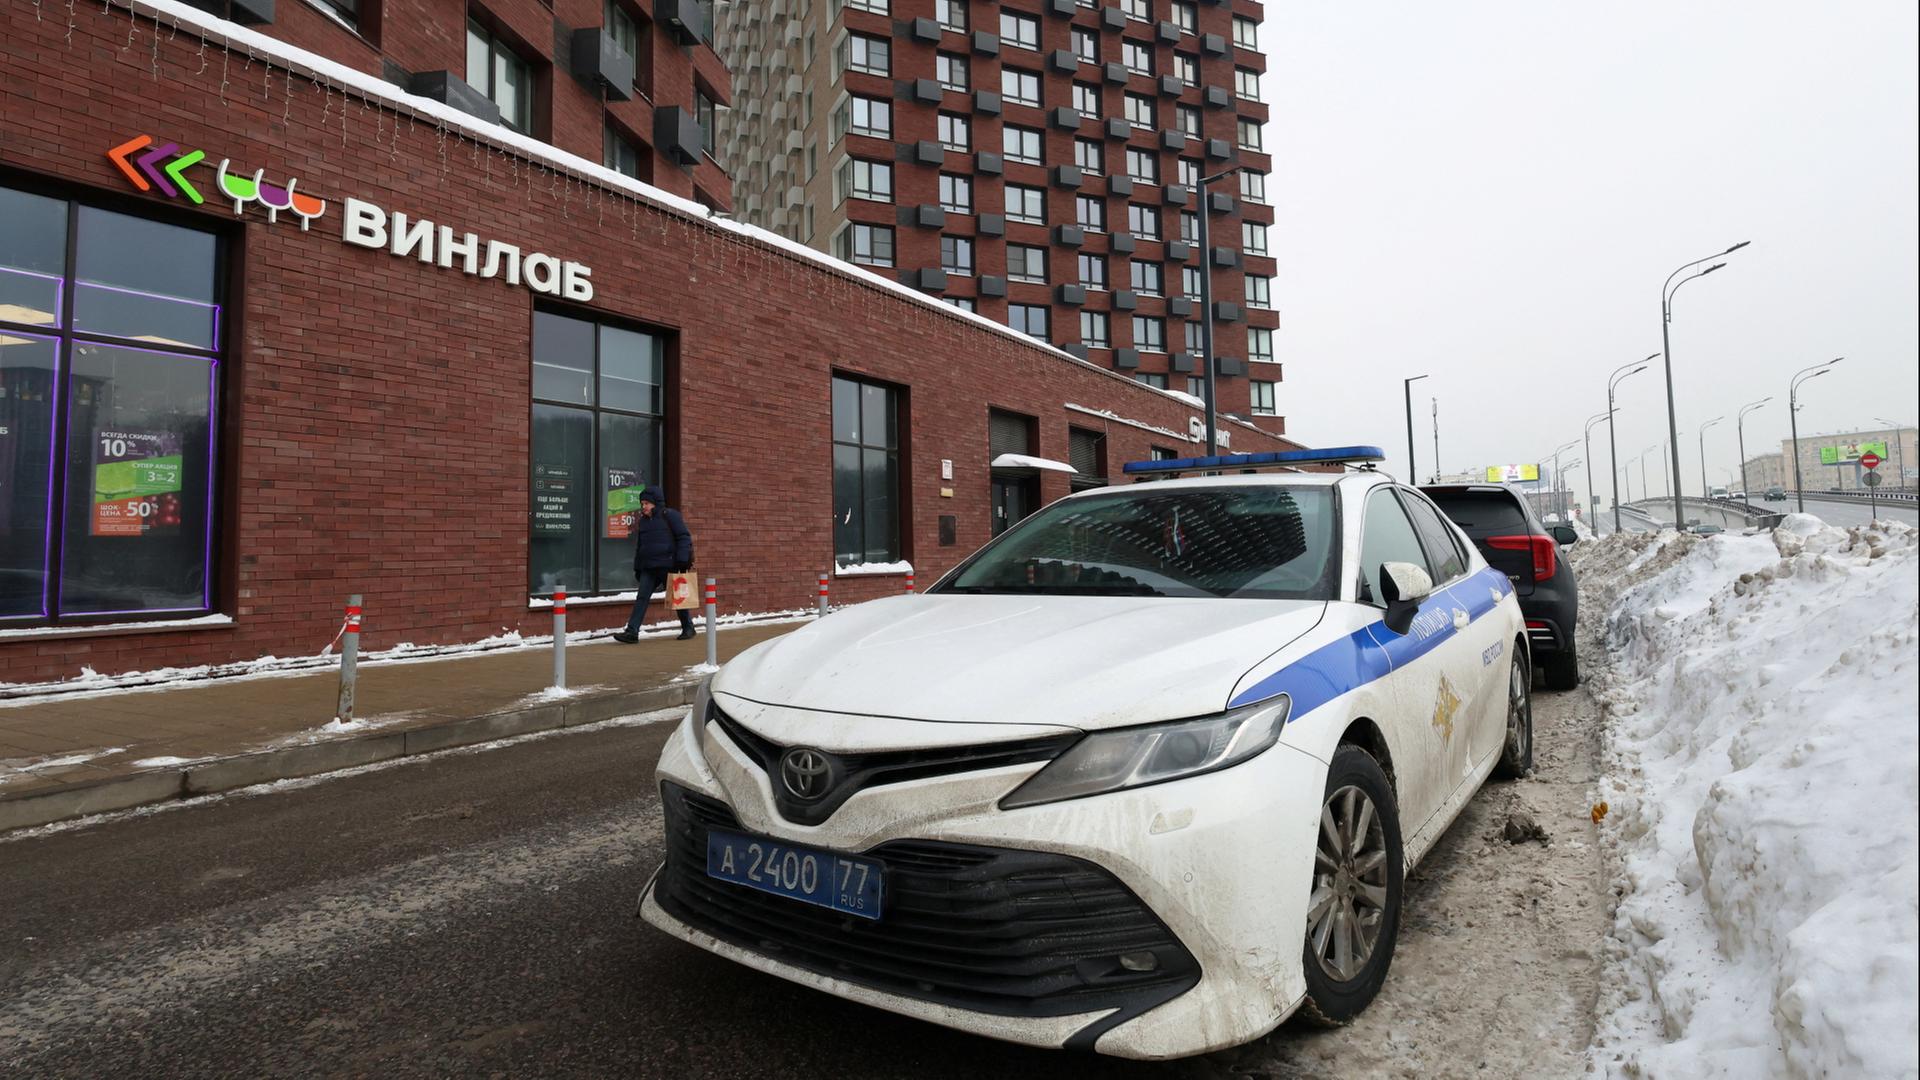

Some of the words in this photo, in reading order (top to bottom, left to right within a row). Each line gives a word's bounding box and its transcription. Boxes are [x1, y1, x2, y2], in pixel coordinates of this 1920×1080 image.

[101, 431, 128, 439] ВСЕГДА
[147, 471, 156, 482] 3
[167, 473, 176, 482] 2
[100, 510, 120, 518] ЦЕНА
[721, 845, 735, 875] А
[748, 843, 818, 894] 2400
[838, 859, 869, 895] 77
[840, 894, 864, 910] RUS
